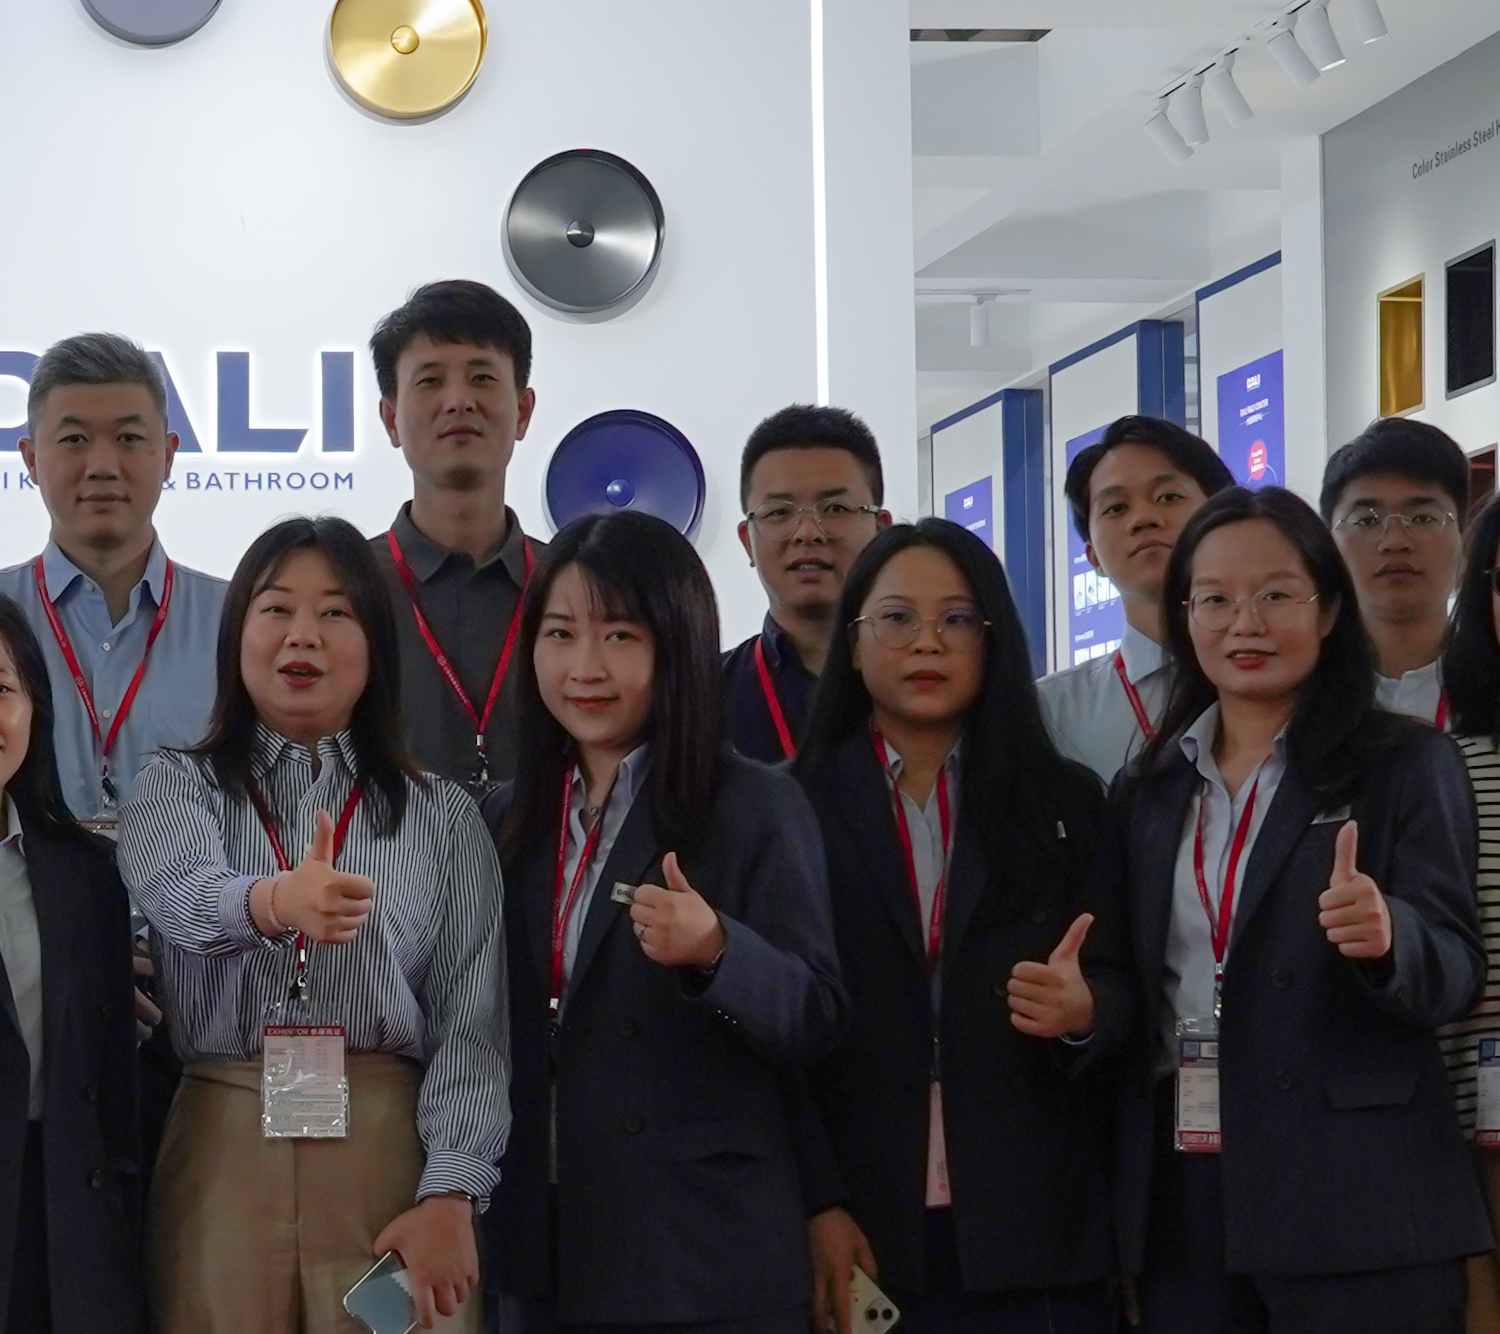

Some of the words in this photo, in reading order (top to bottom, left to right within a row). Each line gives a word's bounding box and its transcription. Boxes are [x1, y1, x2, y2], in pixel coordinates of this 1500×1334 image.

[1412, 159, 1433, 179] Color
[1434, 138, 1472, 168] Stainless
[1473, 121, 1495, 147] Steel
[187, 471, 354, 491] BATHROOM
